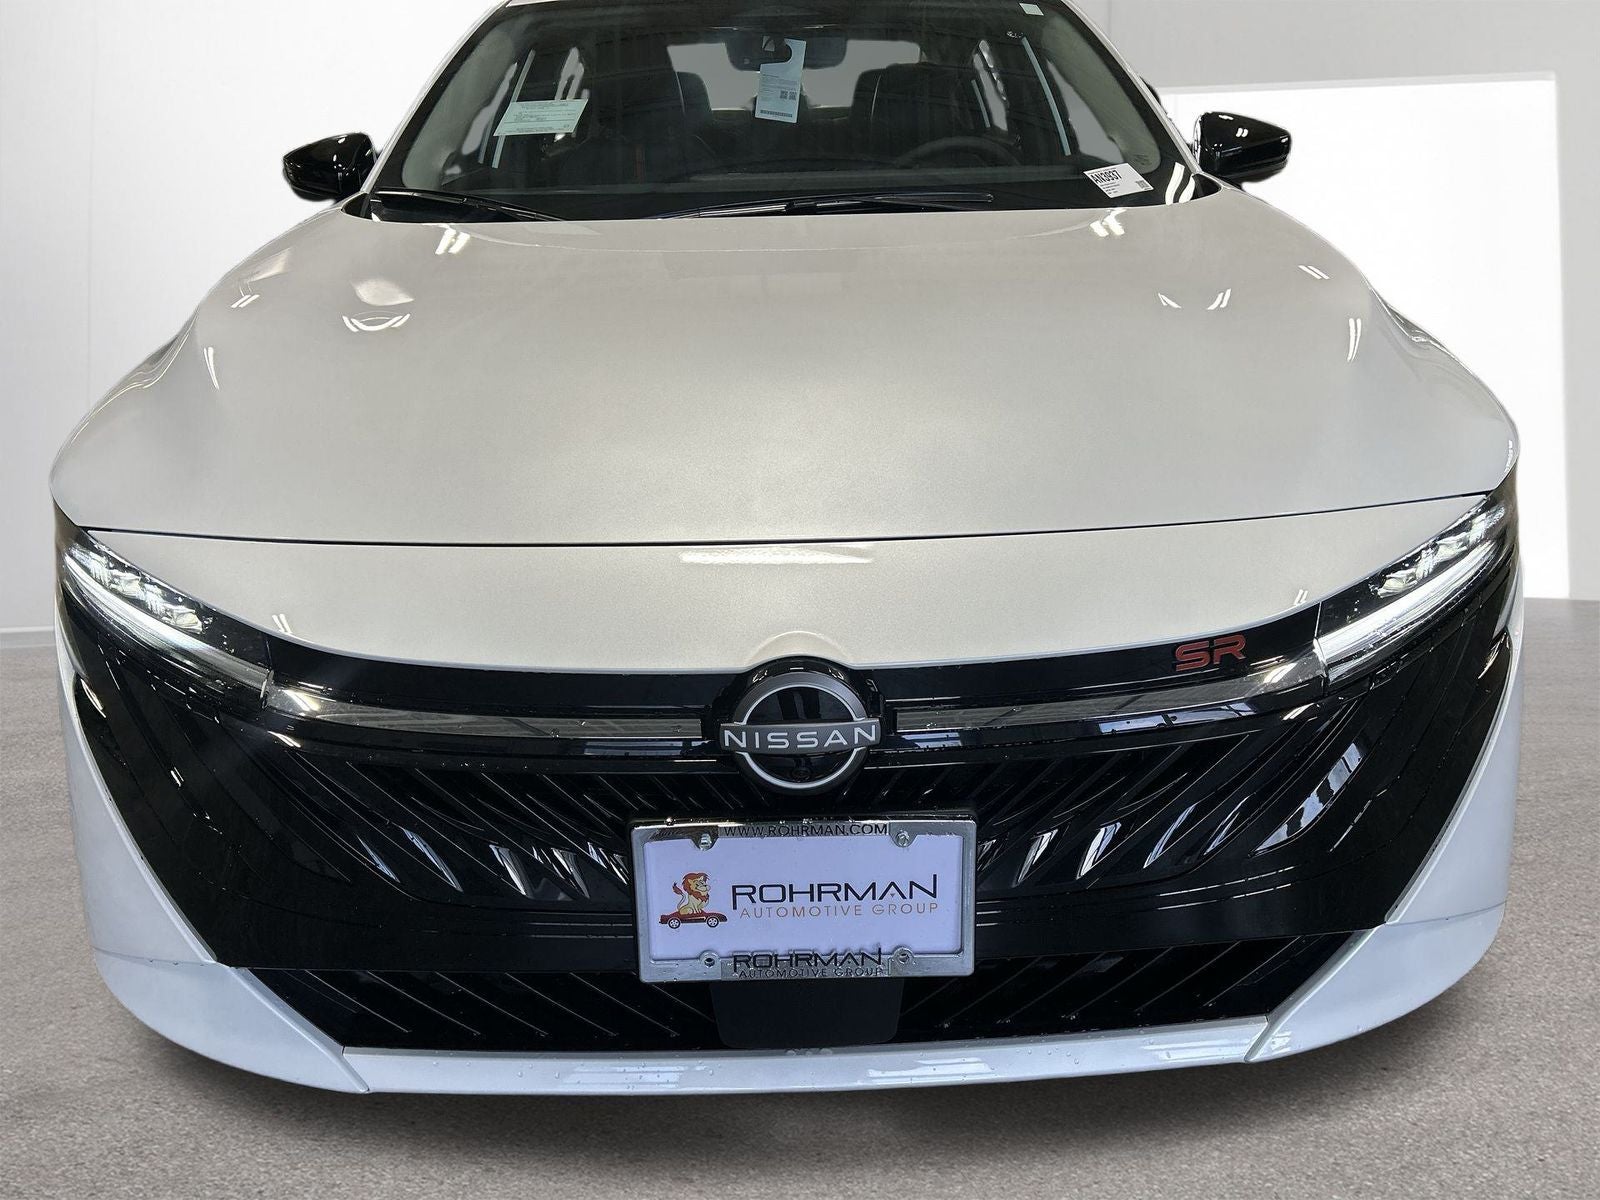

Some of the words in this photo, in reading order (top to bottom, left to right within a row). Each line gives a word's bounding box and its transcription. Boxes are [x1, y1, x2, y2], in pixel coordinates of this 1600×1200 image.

[1090, 169, 1122, 184] AN3937
[1175, 634, 1247, 672] SR
[723, 724, 876, 749] NISSAN
[723, 823, 888, 837] WWW.ROHRMAN.COM
[731, 873, 938, 911] ROHRMAN
[740, 904, 863, 919] AUTOMOTIVE
[872, 902, 939, 915] GROUP
[732, 947, 883, 973] ROHRMAN
[738, 967, 828, 979] AUTOMOTIVE
[834, 966, 884, 977] GROUP
